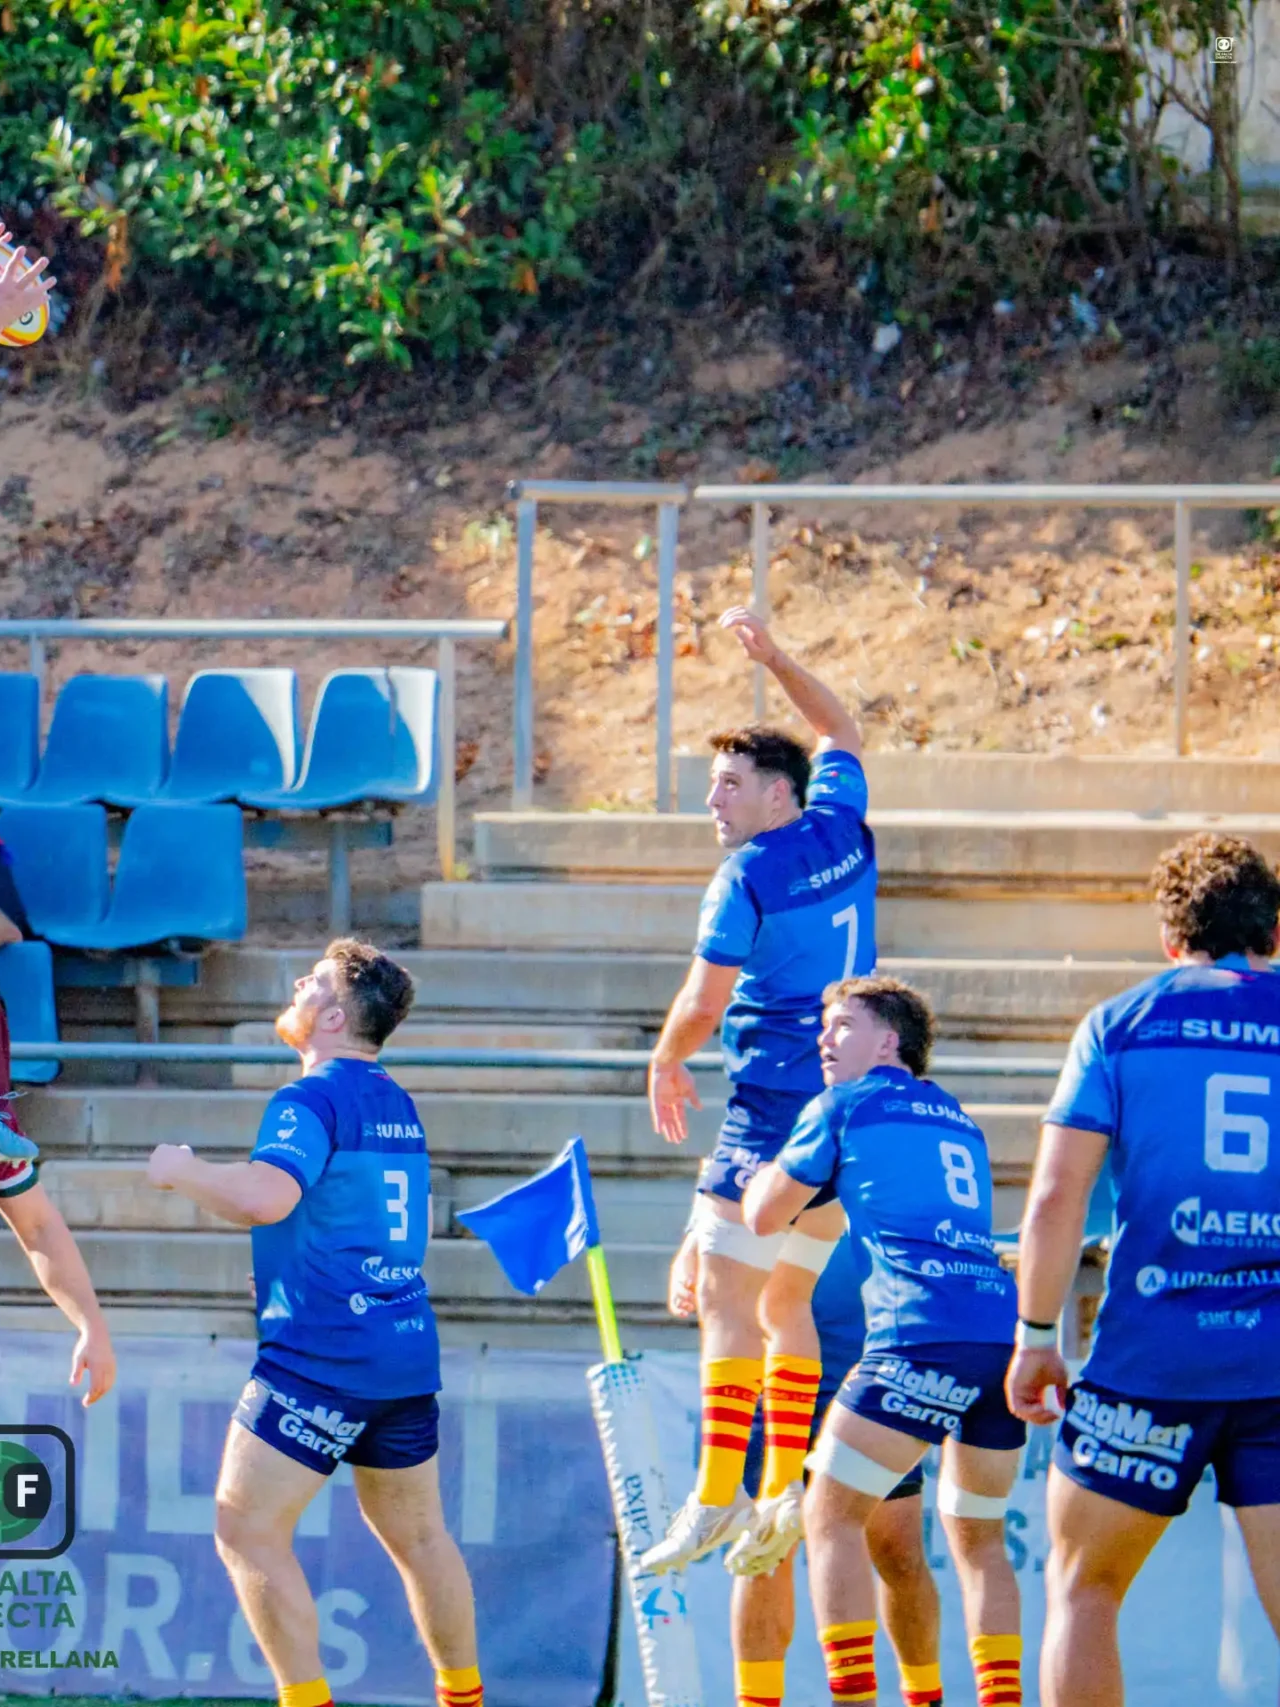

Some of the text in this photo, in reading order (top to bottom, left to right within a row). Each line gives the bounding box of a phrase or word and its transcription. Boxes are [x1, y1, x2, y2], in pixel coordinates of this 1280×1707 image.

[832, 903, 859, 981] 7
[1204, 1072, 1271, 1174] 6
[383, 1170, 409, 1241] 3
[938, 1140, 980, 1210] 8
[881, 1391, 961, 1431] Garro
[1073, 1433, 1178, 1490] Garro
